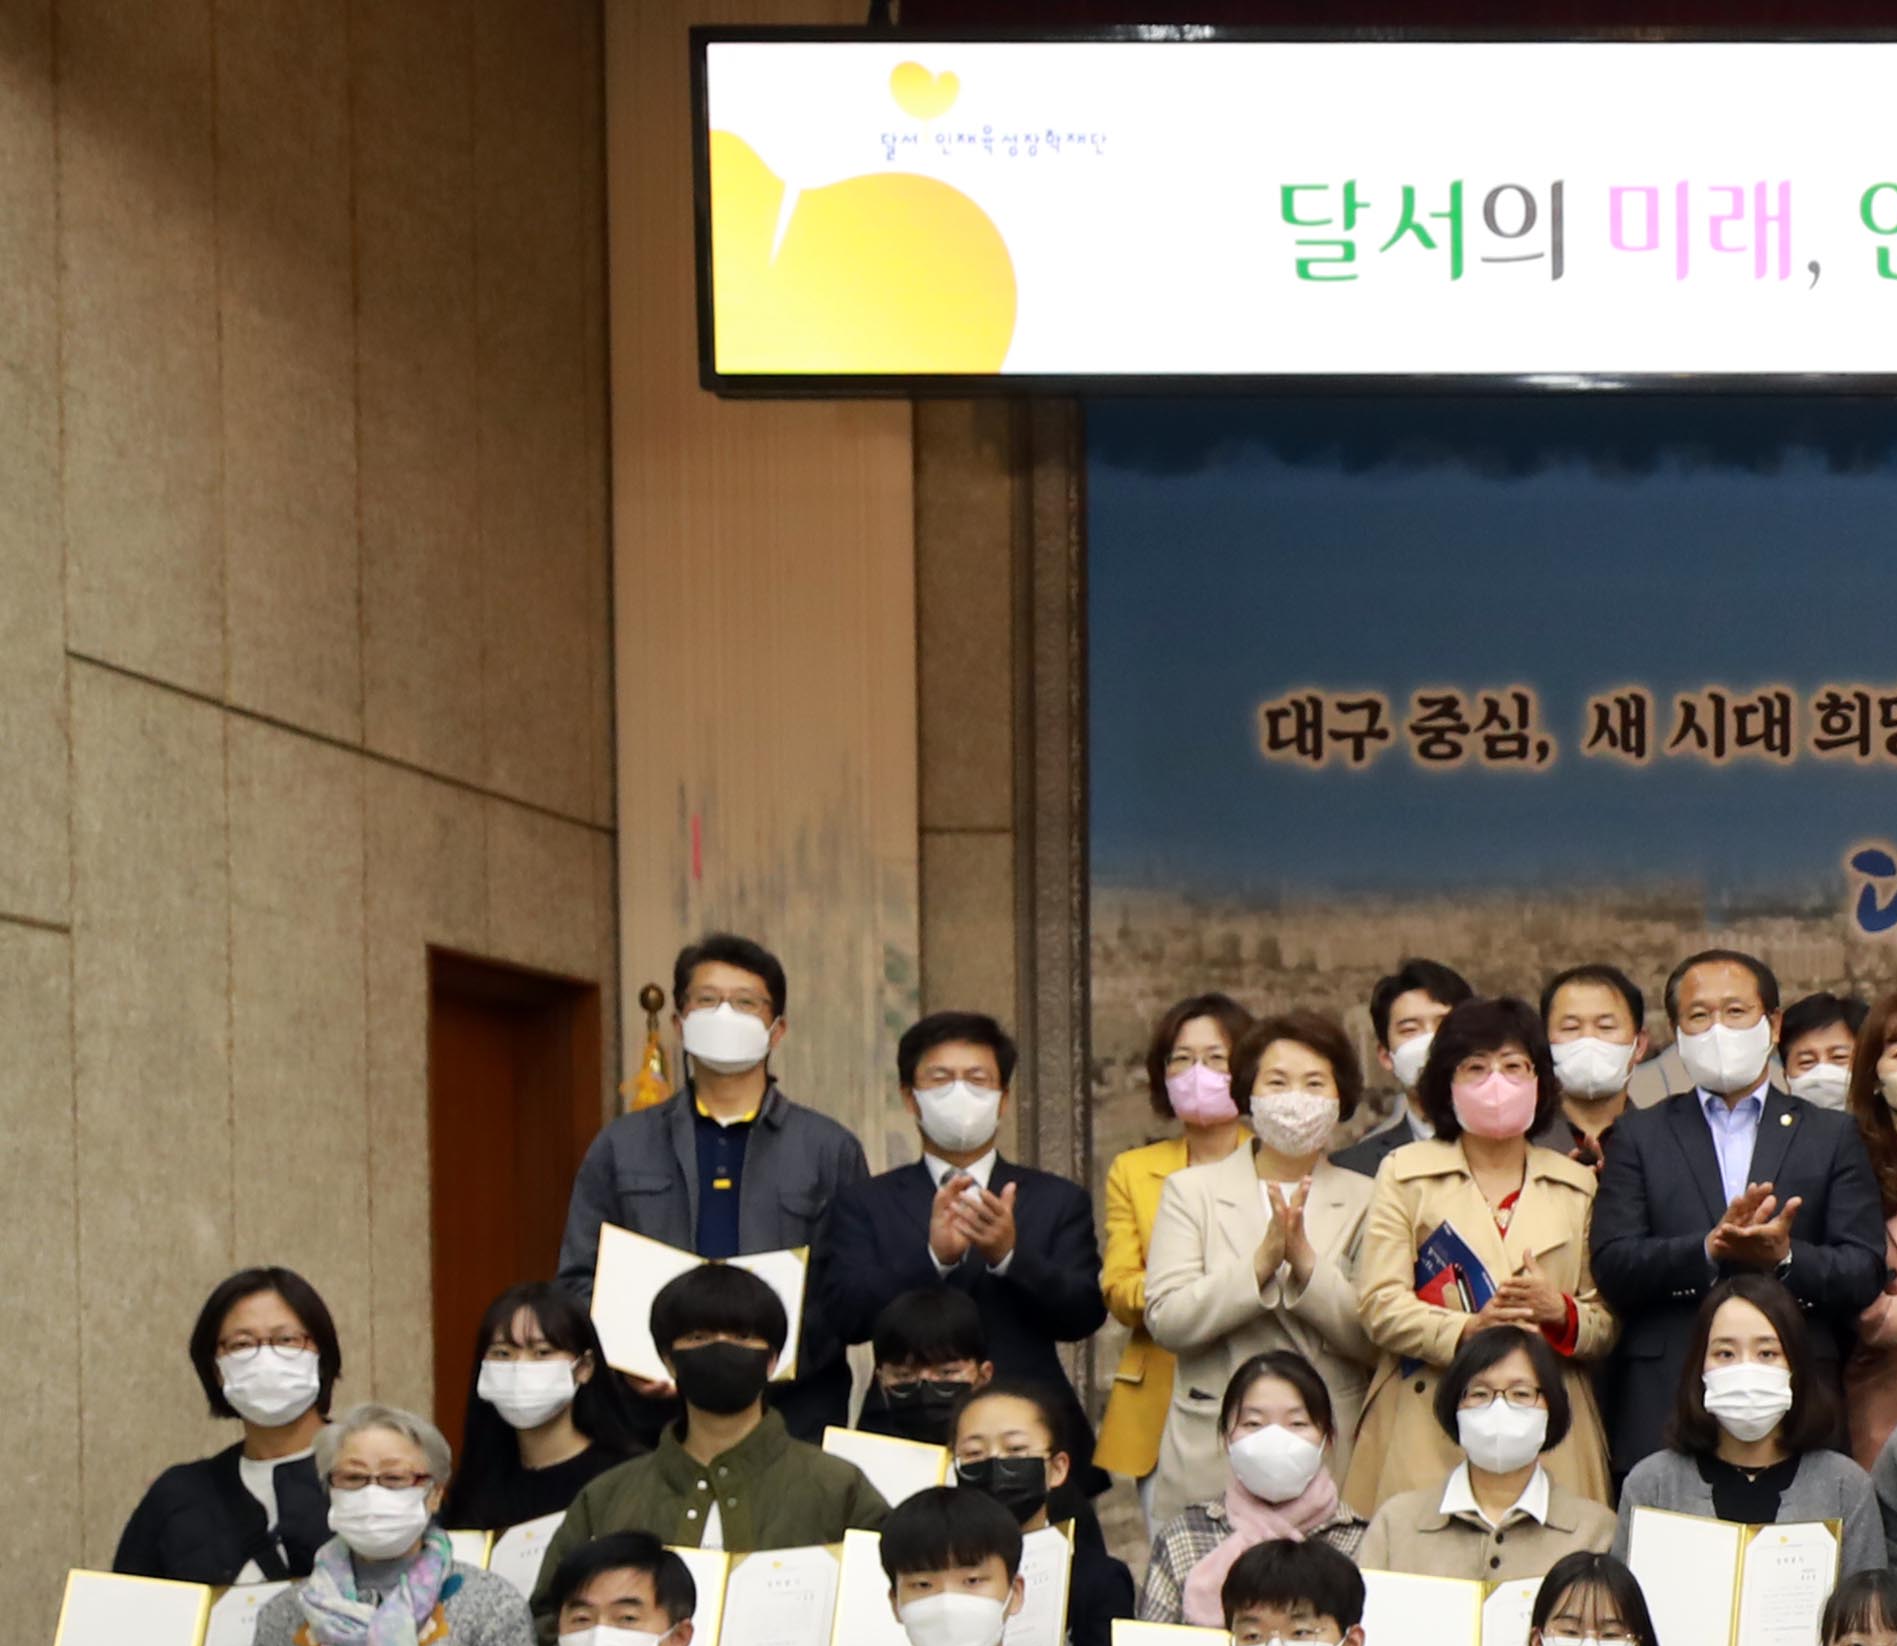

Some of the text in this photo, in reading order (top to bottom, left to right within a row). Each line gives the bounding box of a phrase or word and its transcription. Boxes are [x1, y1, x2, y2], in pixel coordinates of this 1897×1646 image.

[1280, 179, 1565, 282] 달서의
[1609, 179, 1822, 289] 미래,
[1264, 696, 1390, 763] 대구
[1409, 692, 1552, 763] 중심,
[1587, 694, 1648, 759] 새
[1671, 692, 1792, 759] 시대
